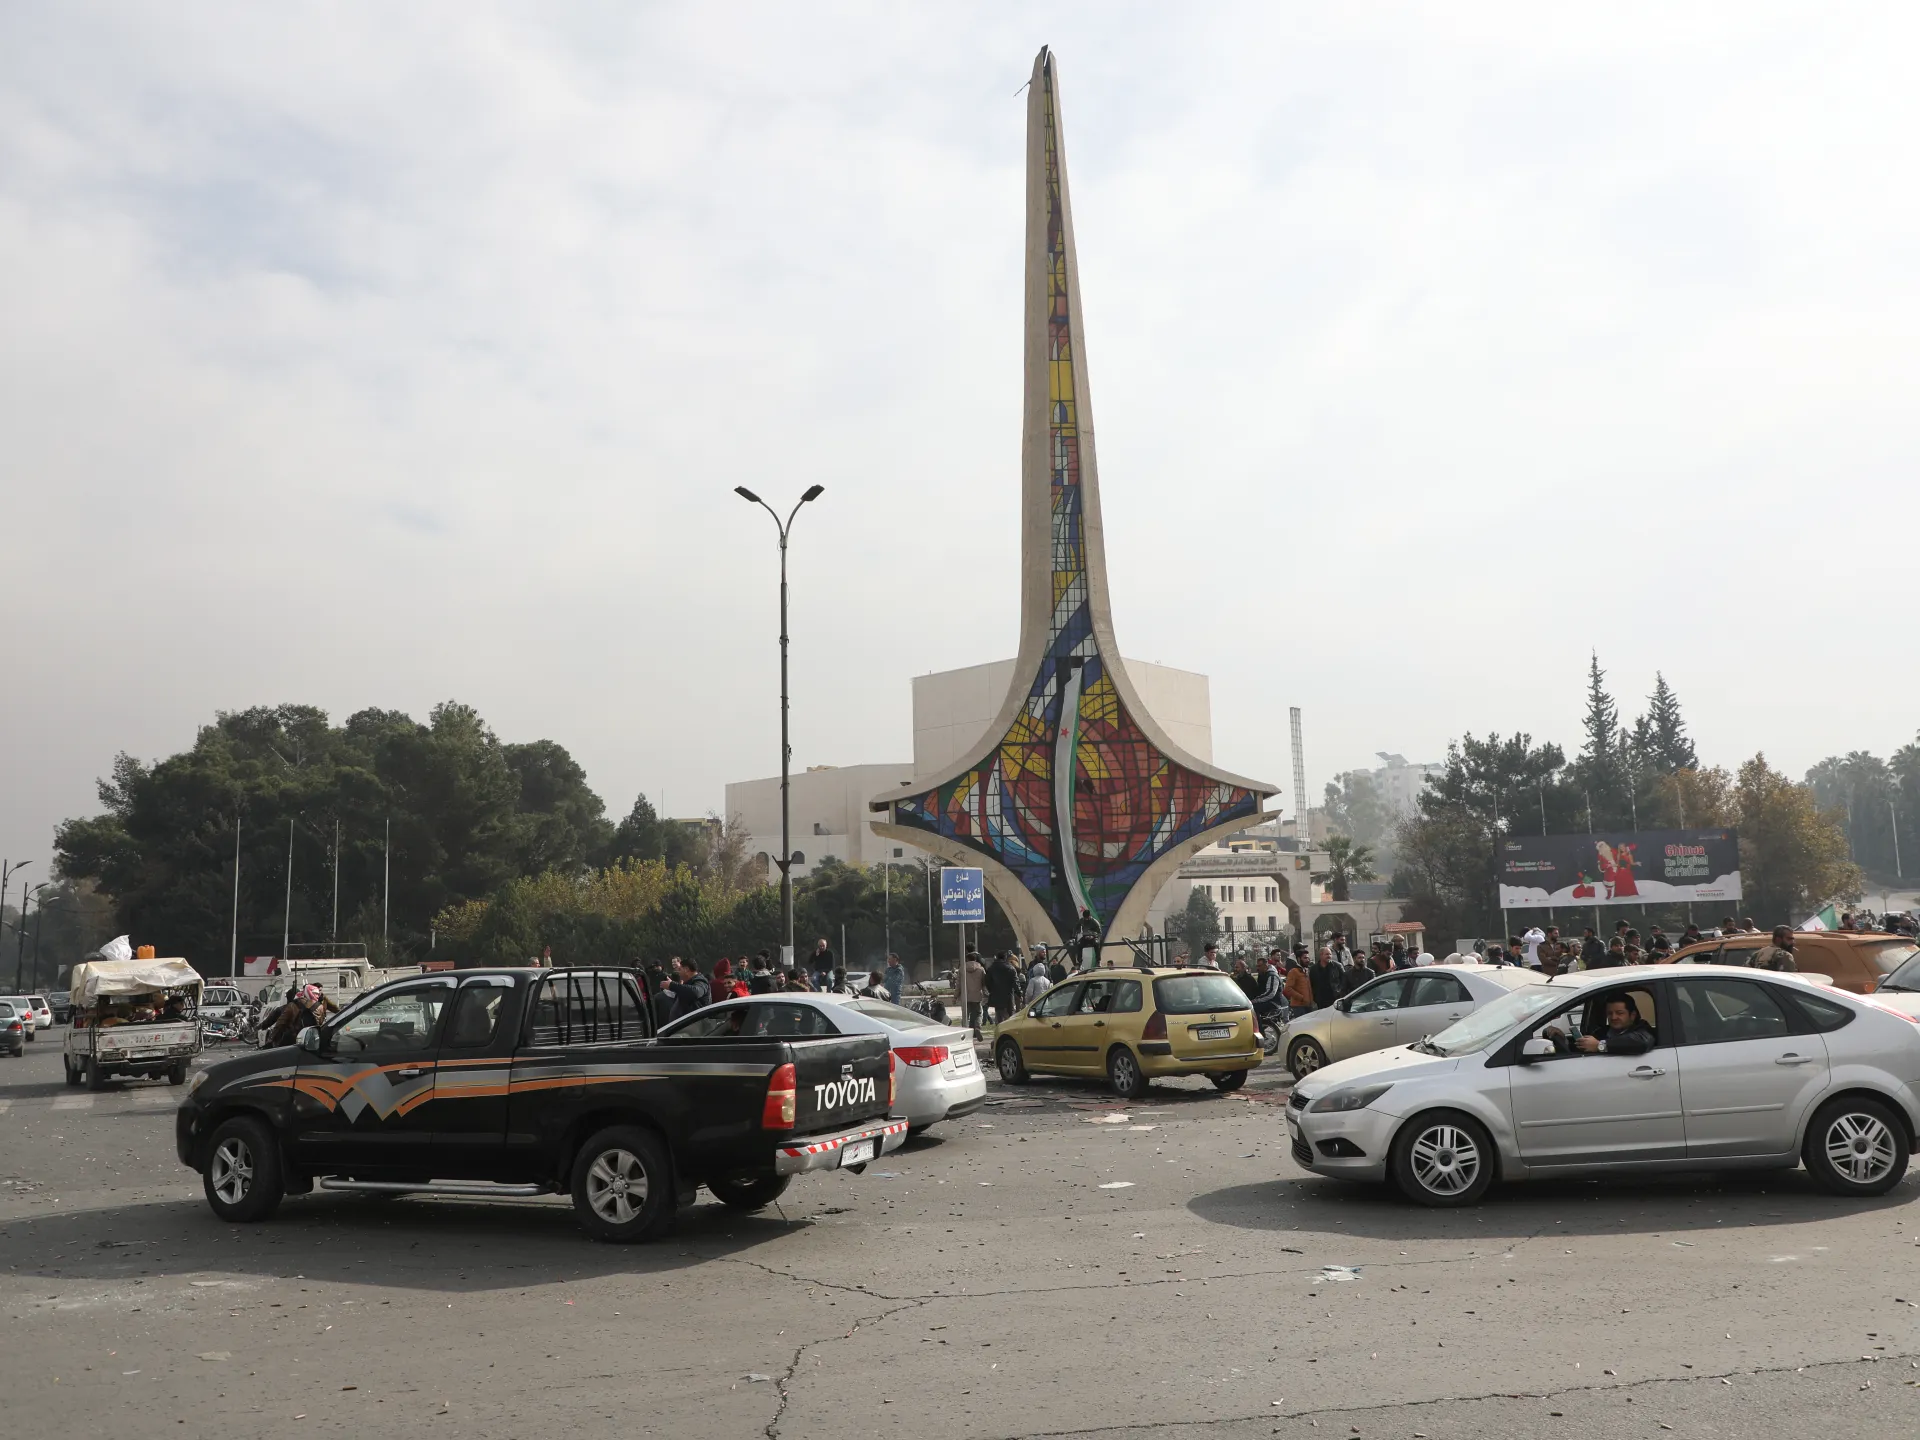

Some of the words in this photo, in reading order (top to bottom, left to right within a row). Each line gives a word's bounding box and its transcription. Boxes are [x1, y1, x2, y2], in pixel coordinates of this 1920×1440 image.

[1676, 855, 1708, 867] Magical
[956, 872, 969, 882] شارع
[1664, 866, 1709, 877] Christmas
[943, 888, 966, 904] القوتلي
[966, 888, 981, 903] شكري
[814, 1077, 876, 1111] TOYOTA
